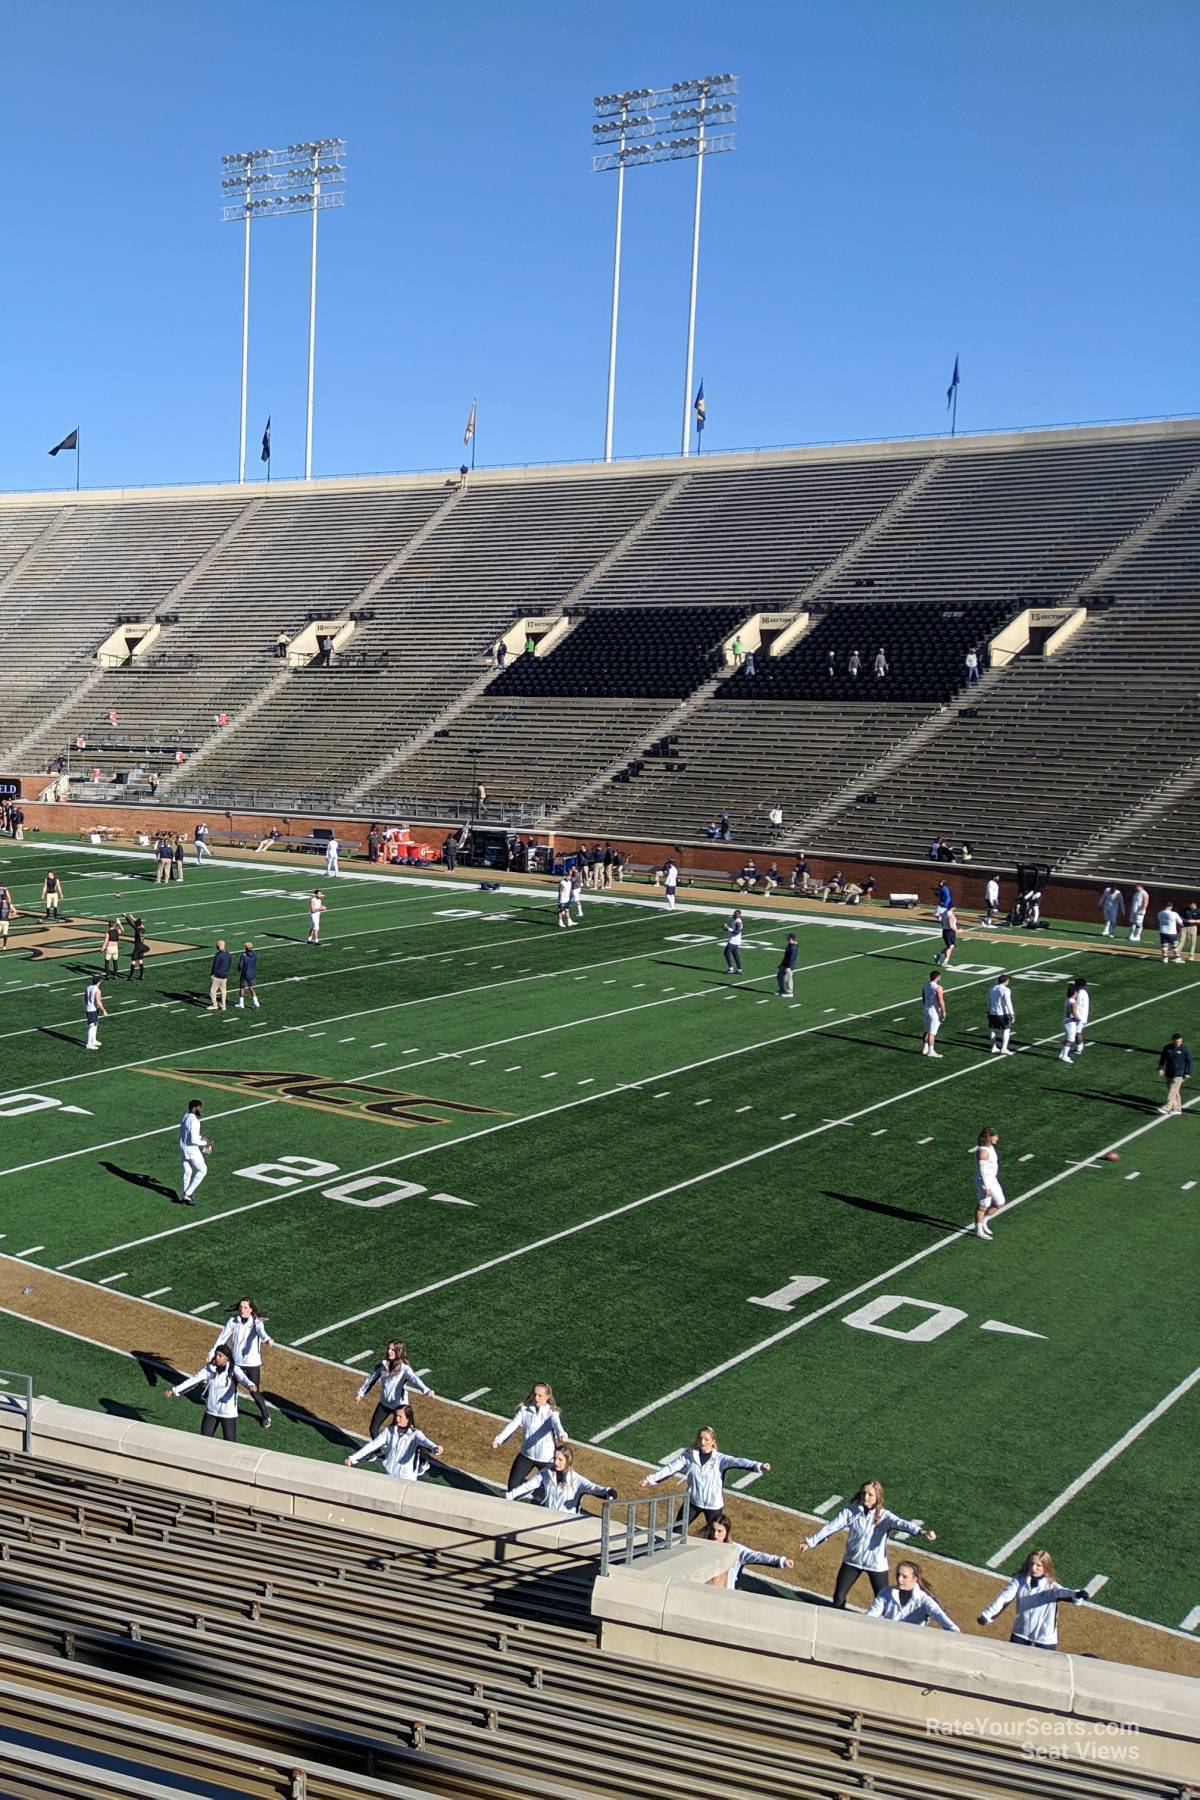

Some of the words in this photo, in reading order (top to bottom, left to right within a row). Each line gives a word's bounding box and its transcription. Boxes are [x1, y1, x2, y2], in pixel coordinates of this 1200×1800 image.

[129, 1067, 517, 1128] ACC
[232, 1155, 428, 1208] 20
[745, 1274, 969, 1342] 10
